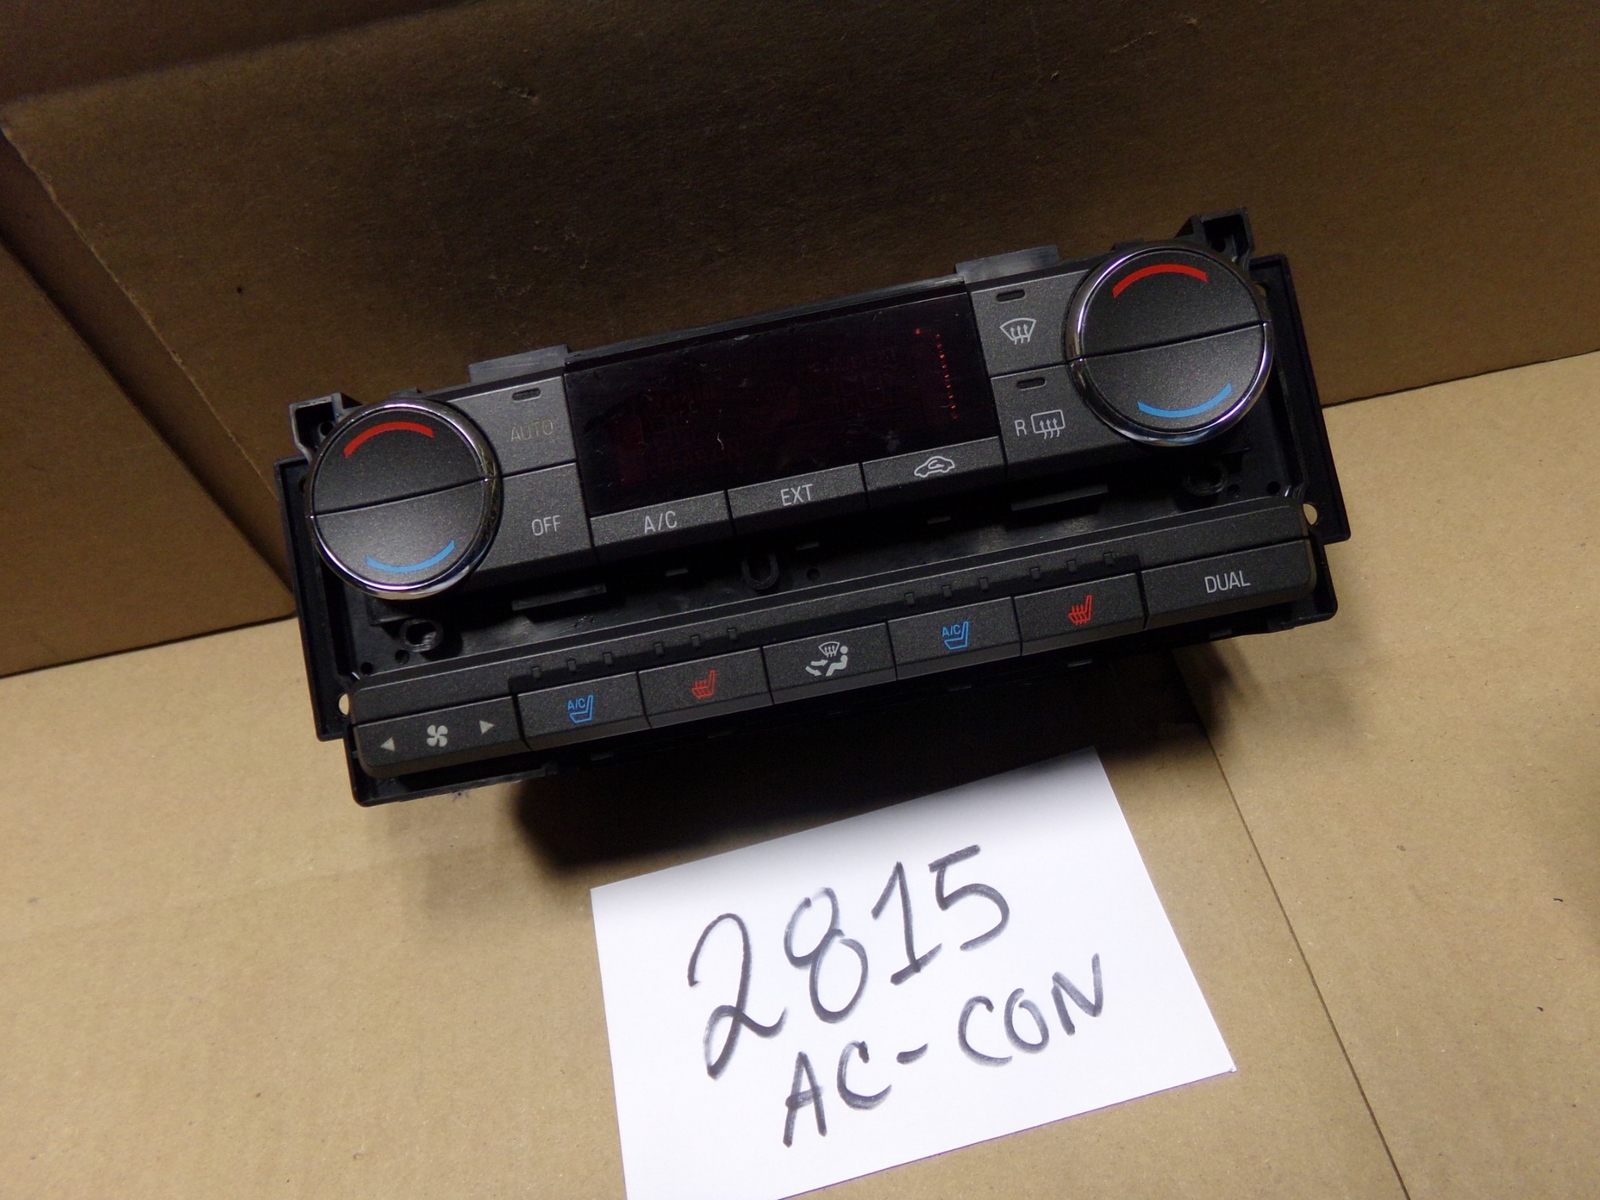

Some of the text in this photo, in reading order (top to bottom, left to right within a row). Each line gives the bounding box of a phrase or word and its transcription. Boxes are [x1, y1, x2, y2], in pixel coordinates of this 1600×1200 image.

[510, 419, 553, 442] AUTO
[1014, 419, 1027, 436] R
[780, 483, 814, 506] EXT
[531, 514, 561, 536] OFF
[643, 510, 678, 533] A/C
[1204, 573, 1251, 593] DUAL
[942, 624, 961, 639] A/C
[567, 697, 587, 712] A/C
[687, 844, 1010, 1079] 2815
